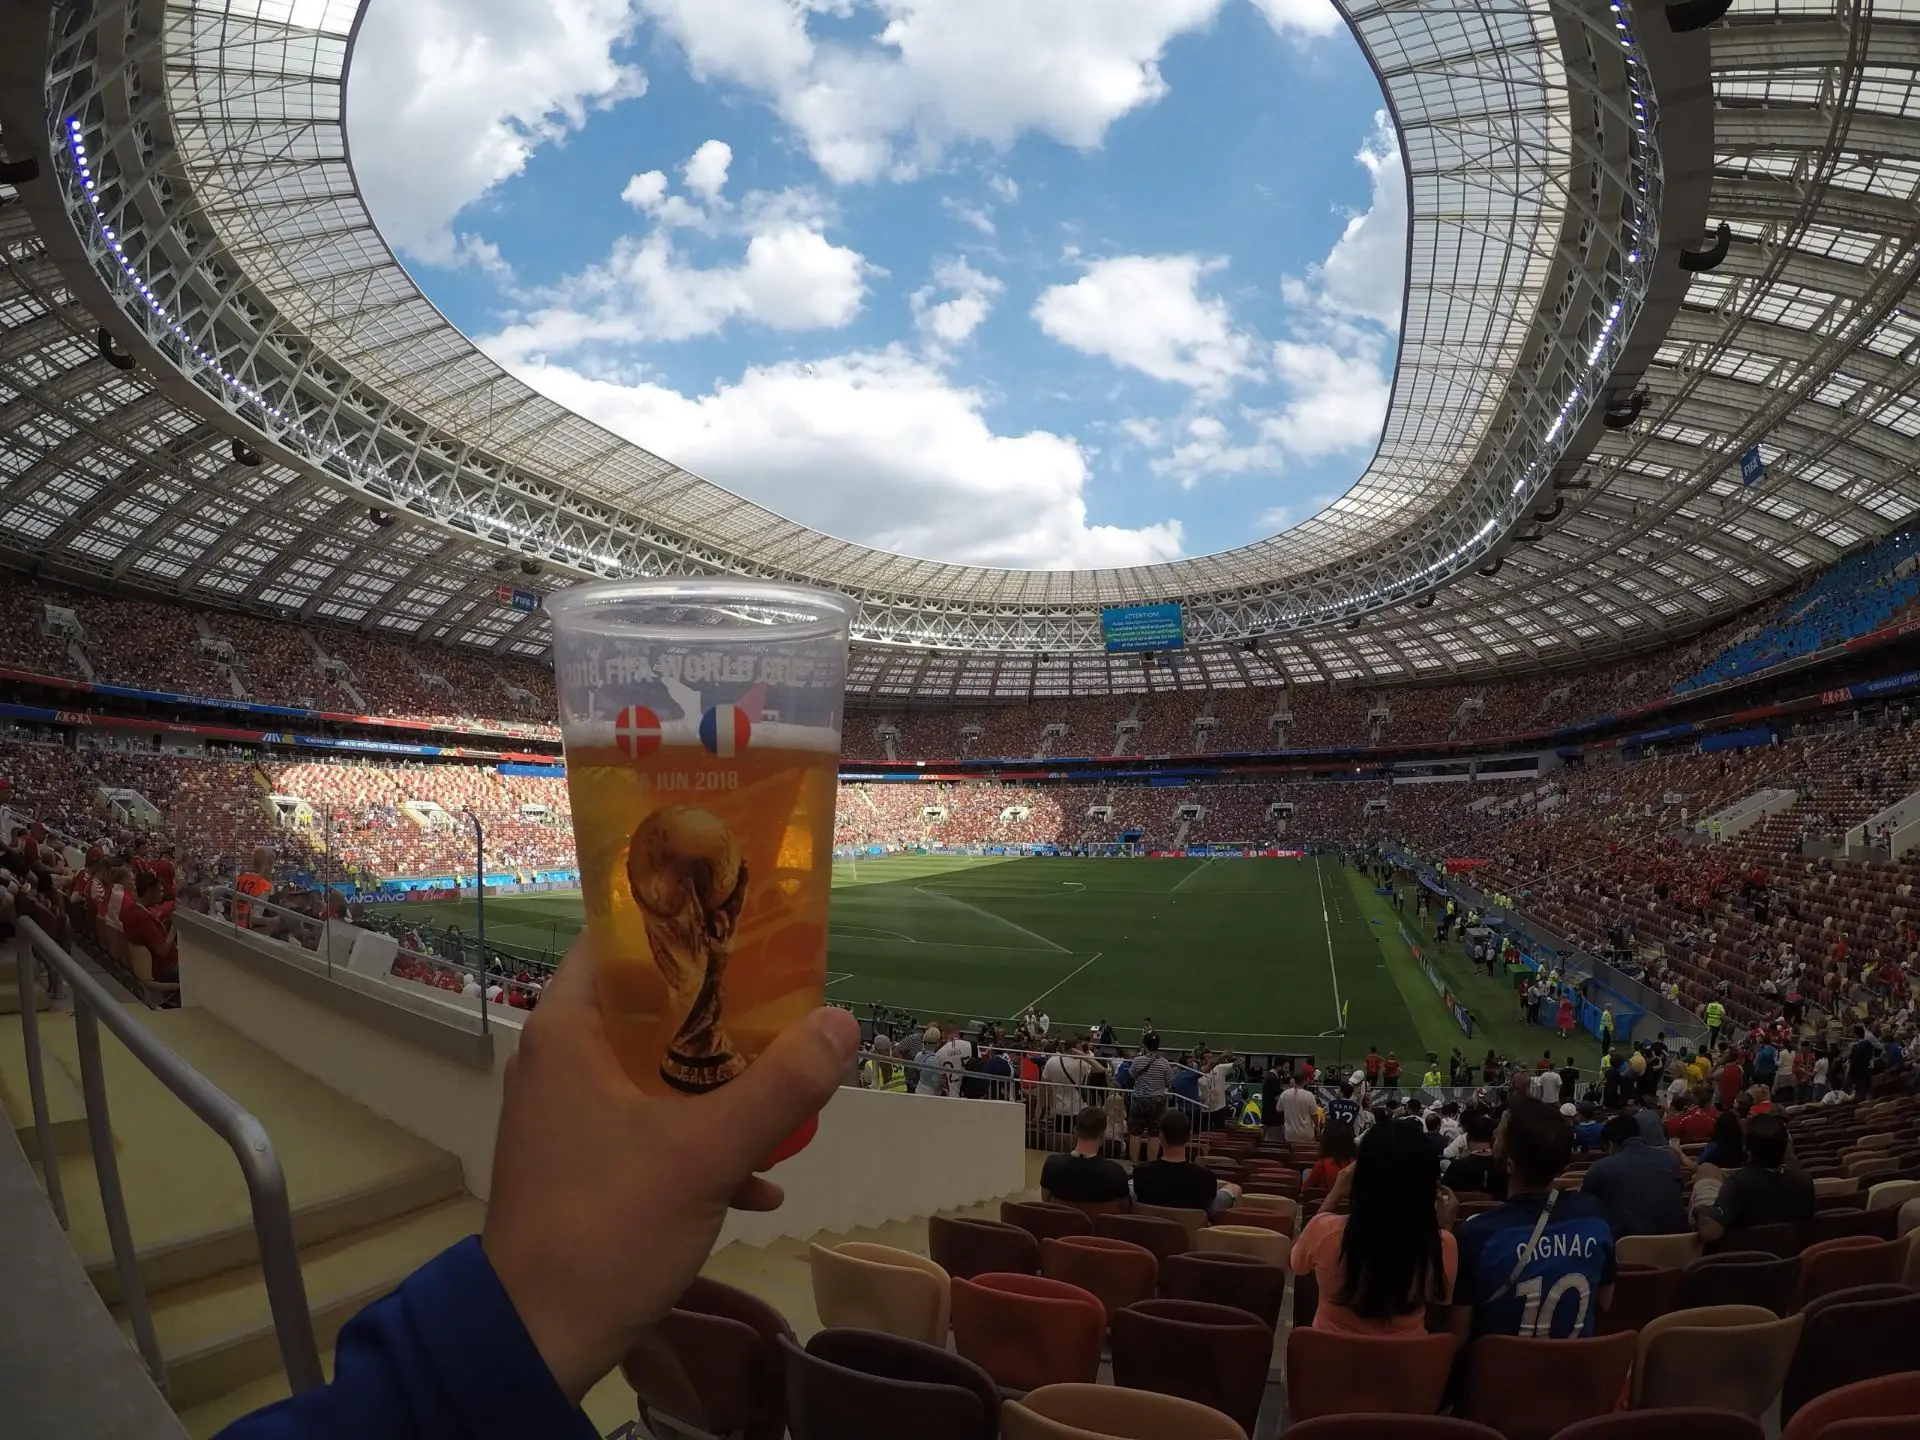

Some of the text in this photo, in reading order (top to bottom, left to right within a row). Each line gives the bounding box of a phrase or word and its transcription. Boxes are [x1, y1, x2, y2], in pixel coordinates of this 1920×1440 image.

[1743, 457, 1759, 477] FIFA
[515, 595, 532, 606] FIFA
[605, 657, 655, 685] FIFA
[661, 653, 758, 684] WORLD
[656, 771, 690, 791] JUN
[694, 770, 739, 791] 2018
[375, 892, 405, 903] vivo
[1515, 1272, 1591, 1341] 10
